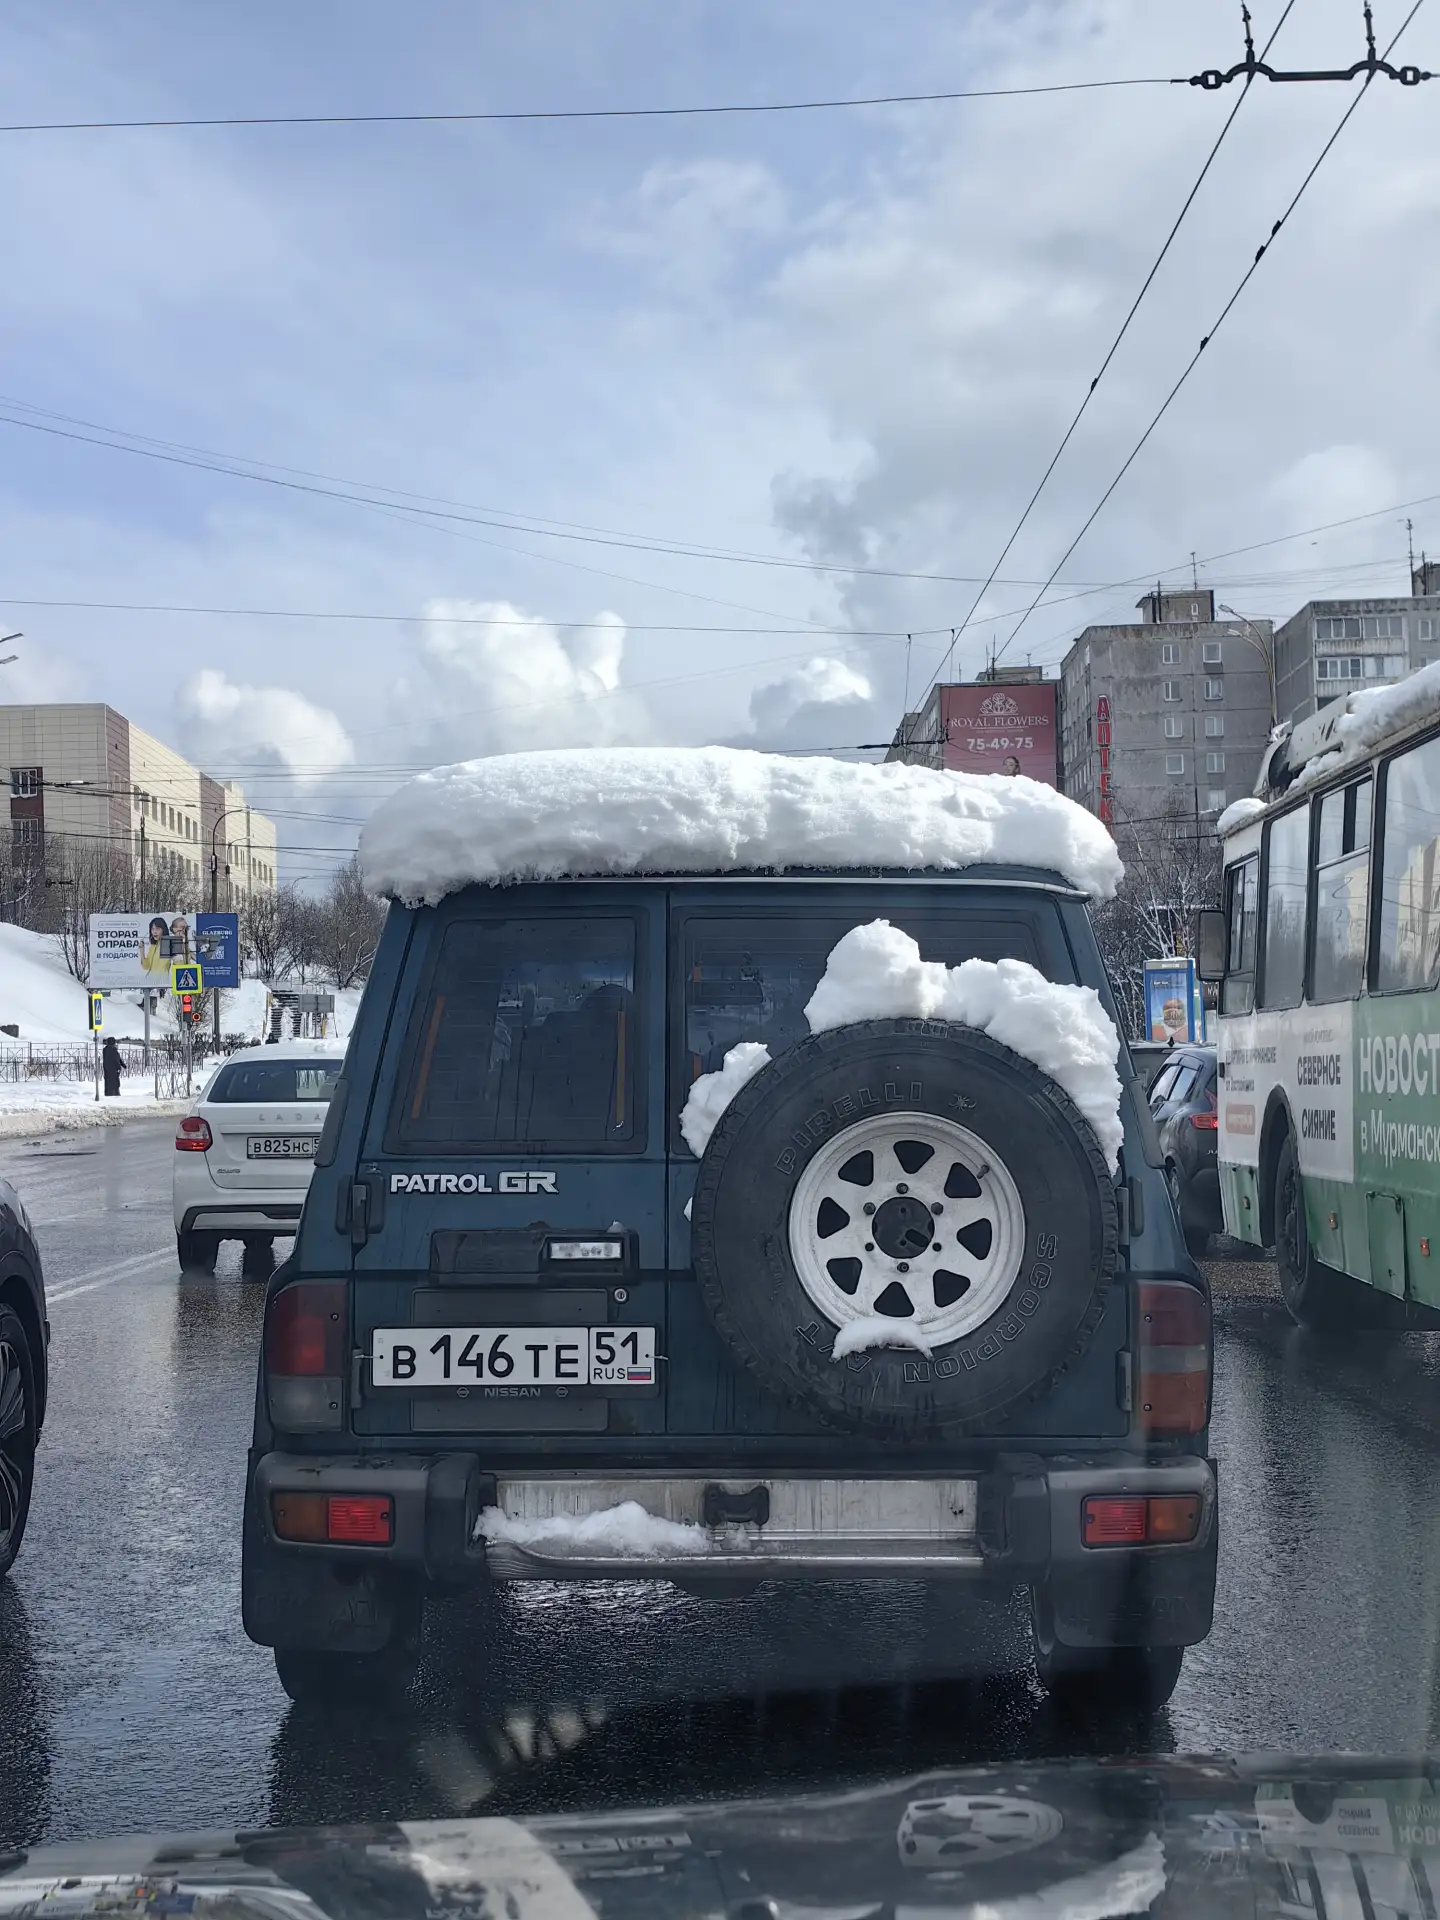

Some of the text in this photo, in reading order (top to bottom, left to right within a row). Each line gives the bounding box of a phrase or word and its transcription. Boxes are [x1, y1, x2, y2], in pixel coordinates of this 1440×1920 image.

[951, 715, 1049, 728] ROYAL FLOWERS
[967, 737, 1034, 750] 75-49-75
[97, 930, 138, 939] ВТОРАЯ
[97, 940, 139, 949] ОПРАВА
[1297, 1054, 1341, 1086] СЕВЕРНОЕ
[1360, 1032, 1440, 1096] НОВОСТ
[259, 1113, 322, 1121] LADA
[775, 1081, 923, 1176] PIRELLI
[1302, 1108, 1336, 1141] СИЯНИЕ
[1361, 1120, 1368, 1155] в
[390, 1171, 559, 1194] PATROL GR
[904, 1232, 1059, 1383] SCORPION
[595, 1332, 638, 1365] 51
[594, 1367, 626, 1380] RUS
[484, 1387, 541, 1397] NISSAN
